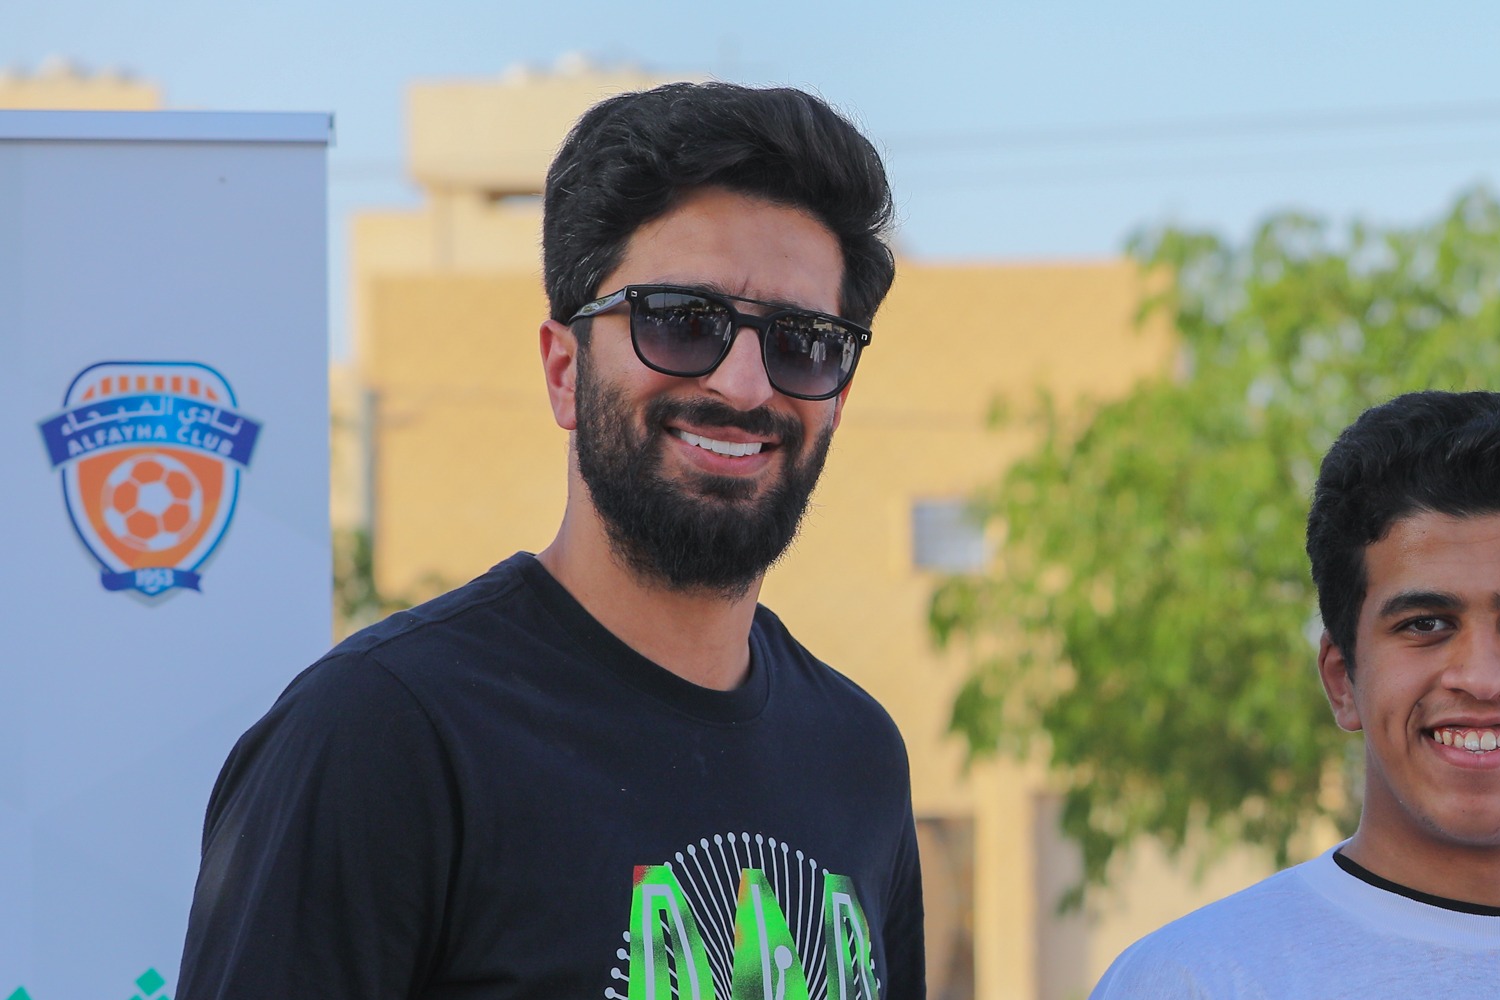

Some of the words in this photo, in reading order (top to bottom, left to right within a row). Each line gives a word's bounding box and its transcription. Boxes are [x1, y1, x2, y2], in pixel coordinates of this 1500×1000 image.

[61, 396, 174, 436] الفيحاء
[179, 408, 243, 437] نادي
[68, 424, 167, 457] ALFAYHA
[176, 425, 235, 456] CLUB
